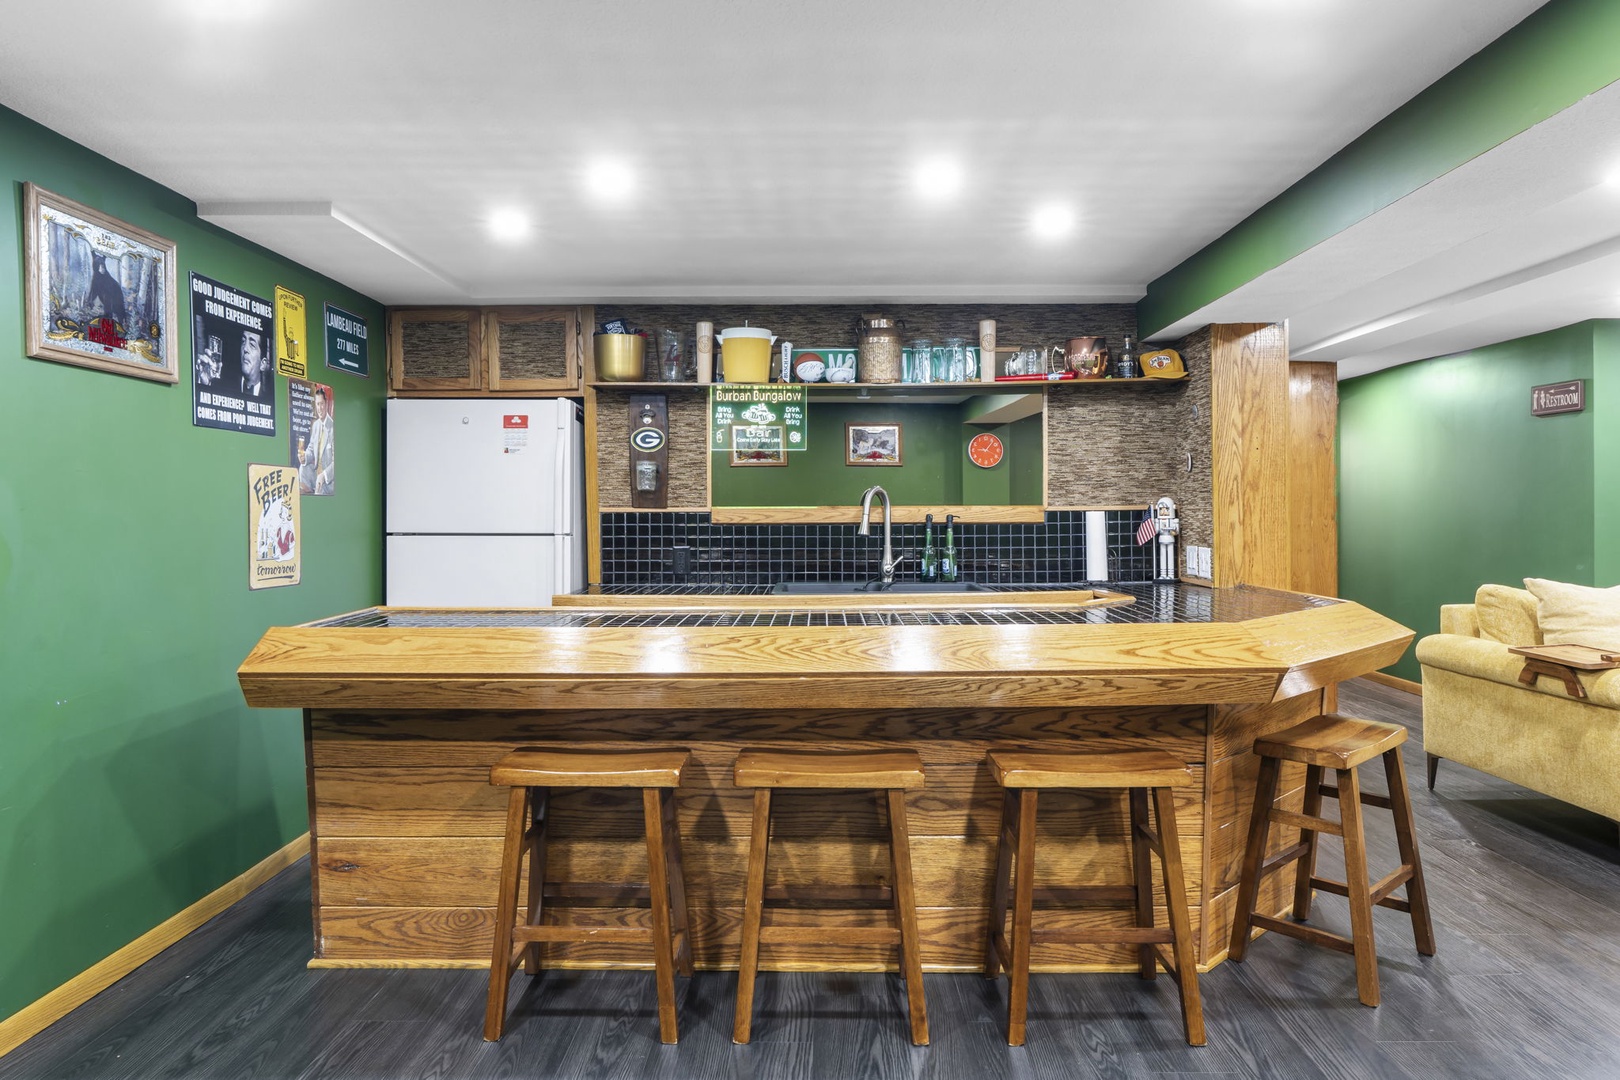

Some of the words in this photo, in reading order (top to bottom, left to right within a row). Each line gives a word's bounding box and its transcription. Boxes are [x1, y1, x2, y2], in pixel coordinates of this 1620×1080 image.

[193, 278, 213, 297] GOOD
[213, 286, 251, 311] JUDGEMENT
[251, 300, 273, 319] COMES
[205, 299, 225, 318] FROM
[225, 306, 264, 331] EXPERIENCE.
[326, 311, 353, 334] LAMBEAU
[353, 321, 368, 340] FIELD
[336, 337, 346, 351] 277
[346, 341, 359, 356] MILES
[200, 391, 212, 405] AND
[212, 393, 245, 410] EXPERIENCE?
[246, 401, 260, 414] WELL
[260, 403, 272, 416] THAT
[716, 390, 751, 401] Burban
[753, 390, 802, 404] Bungalow
[197, 406, 217, 421] COMES
[217, 409, 232, 424] FROM
[232, 412, 247, 426] POOR
[247, 415, 275, 430] JUDGEMENT.
[717, 406, 732, 414] Bring
[785, 418, 801, 426] Bring
[635, 431, 661, 448] G
[253, 469, 283, 505] FREE
[260, 476, 296, 518] BEER!
[256, 563, 297, 577] tomorrow
